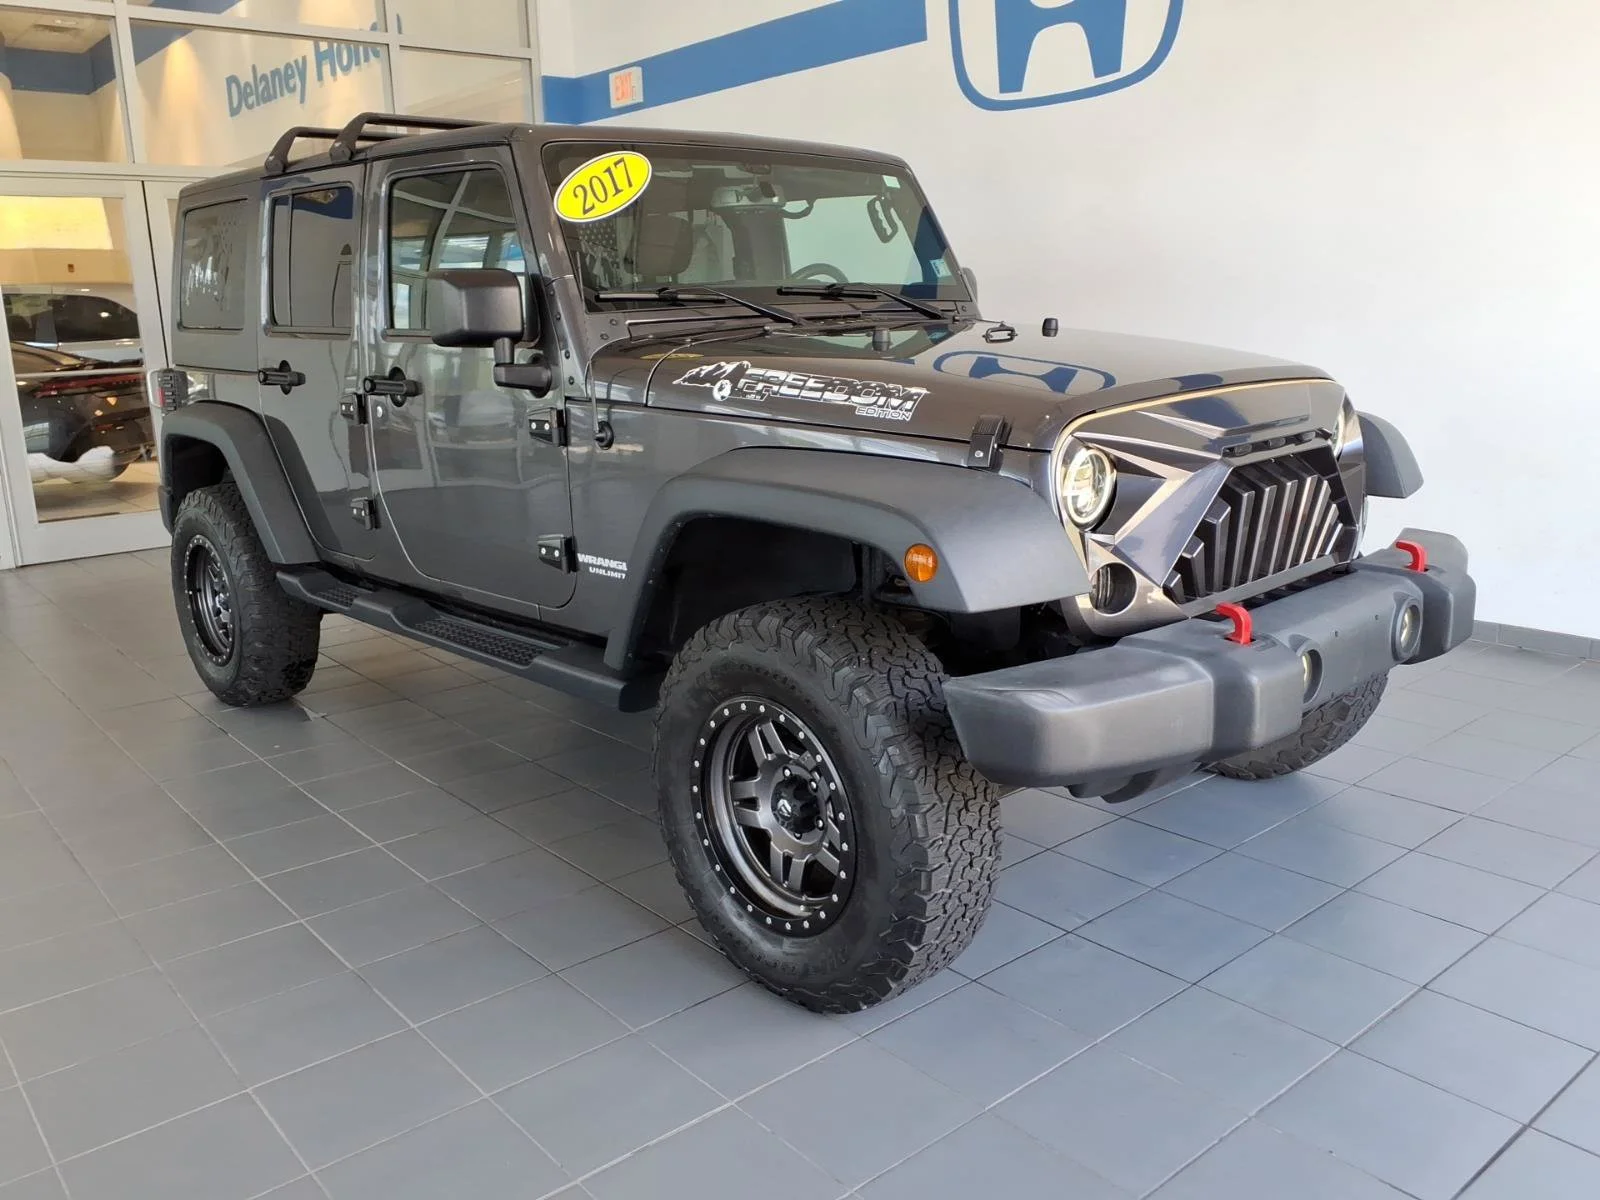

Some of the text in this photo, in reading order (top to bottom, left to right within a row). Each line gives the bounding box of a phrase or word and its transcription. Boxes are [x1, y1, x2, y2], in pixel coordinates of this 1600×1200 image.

[225, 55, 307, 118] Delaney
[573, 157, 633, 215] 2017
[737, 368, 928, 412] FREEDOM
[856, 405, 911, 421] EDITION
